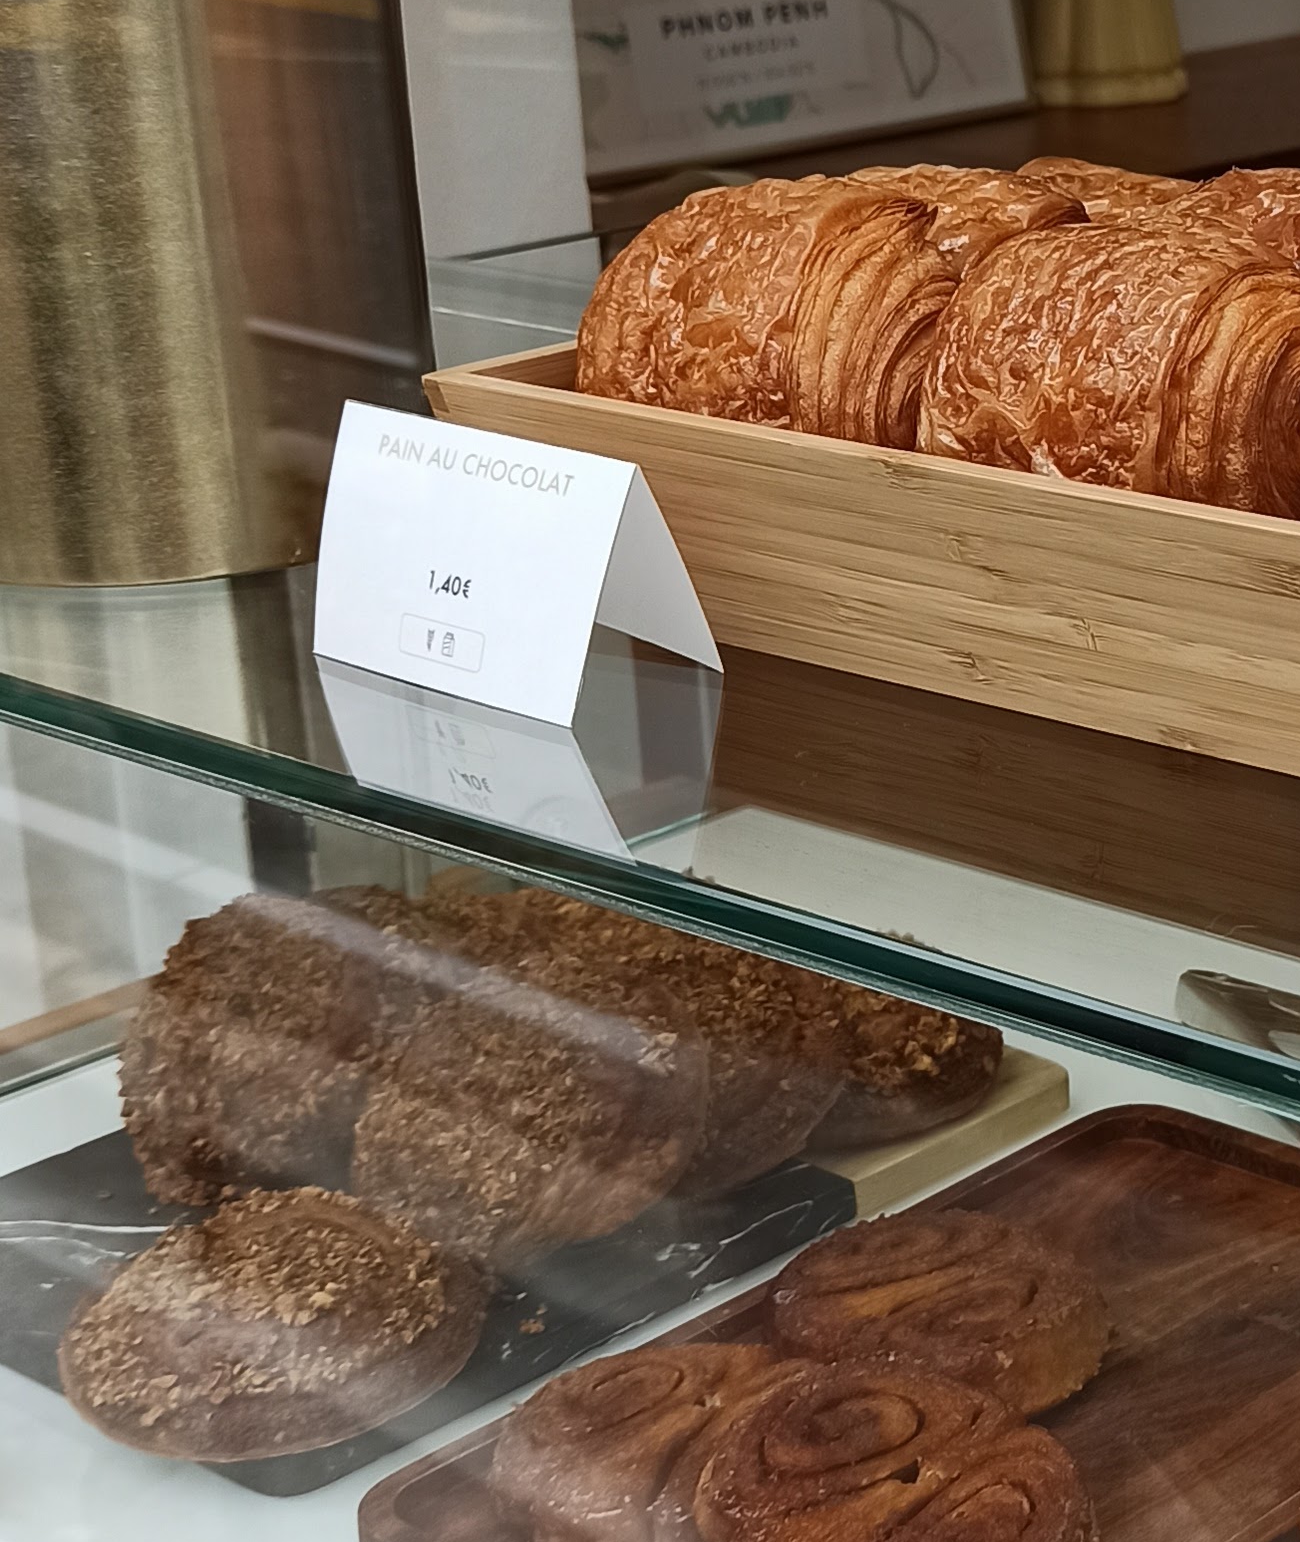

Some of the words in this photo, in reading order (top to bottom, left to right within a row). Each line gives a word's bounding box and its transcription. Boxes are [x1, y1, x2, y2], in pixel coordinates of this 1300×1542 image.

[662, 9, 754, 38] PHNOM
[764, 0, 829, 23] PENH
[378, 434, 425, 464] PAIN
[427, 447, 458, 471] AU
[462, 453, 575, 497] CHOCOLAT
[428, 569, 473, 599] 1,40€
